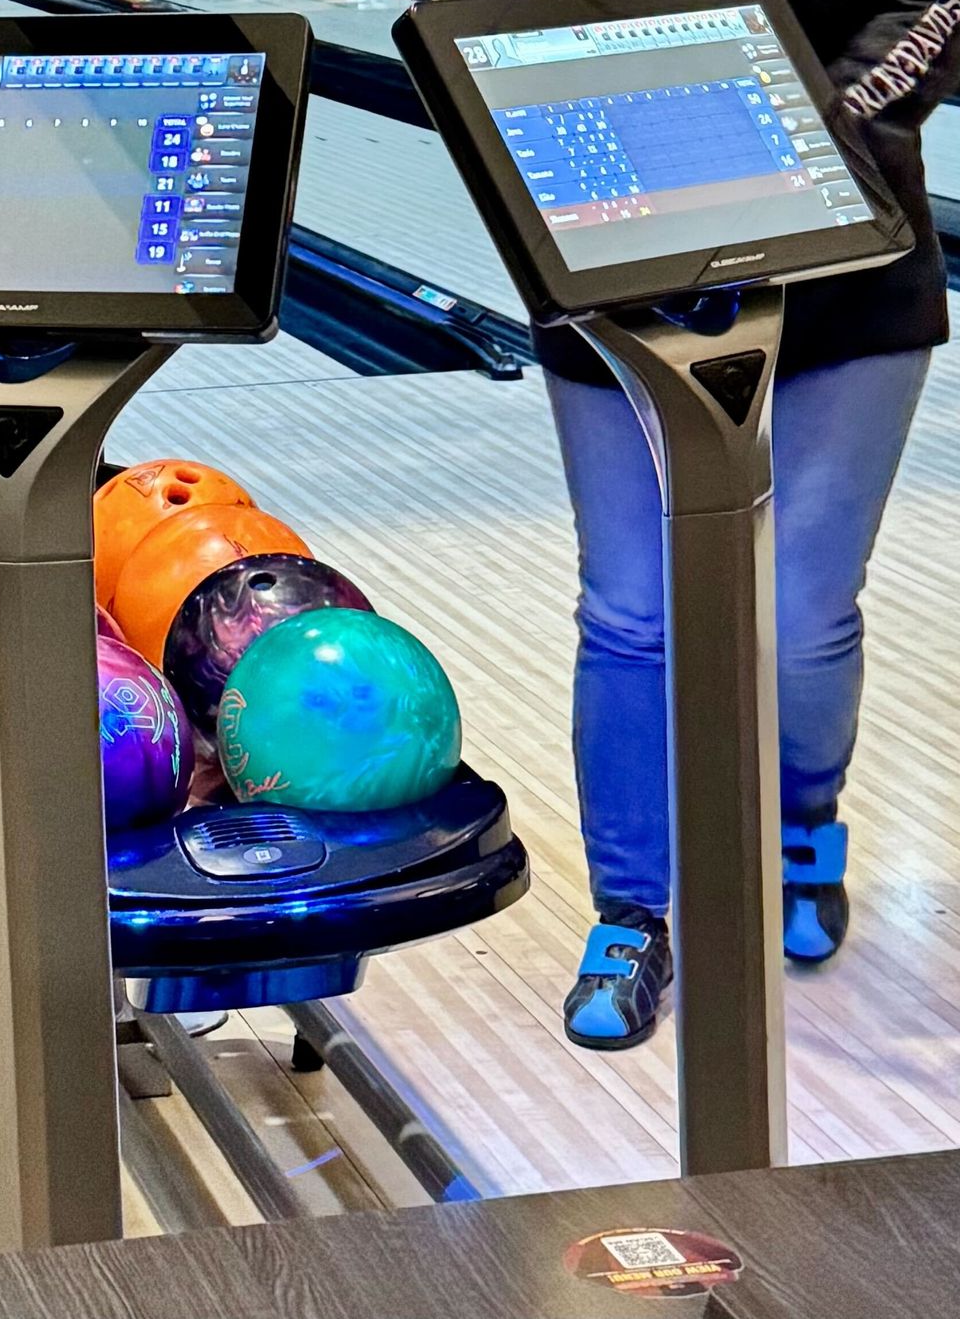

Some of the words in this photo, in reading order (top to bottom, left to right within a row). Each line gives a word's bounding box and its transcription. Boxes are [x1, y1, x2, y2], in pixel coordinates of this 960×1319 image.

[463, 46, 488, 64] 28
[164, 133, 181, 146] 24
[161, 156, 177, 168] 18
[157, 178, 173, 190] 21
[155, 201, 171, 213] 11
[152, 223, 168, 236] 15
[148, 246, 165, 258] 19
